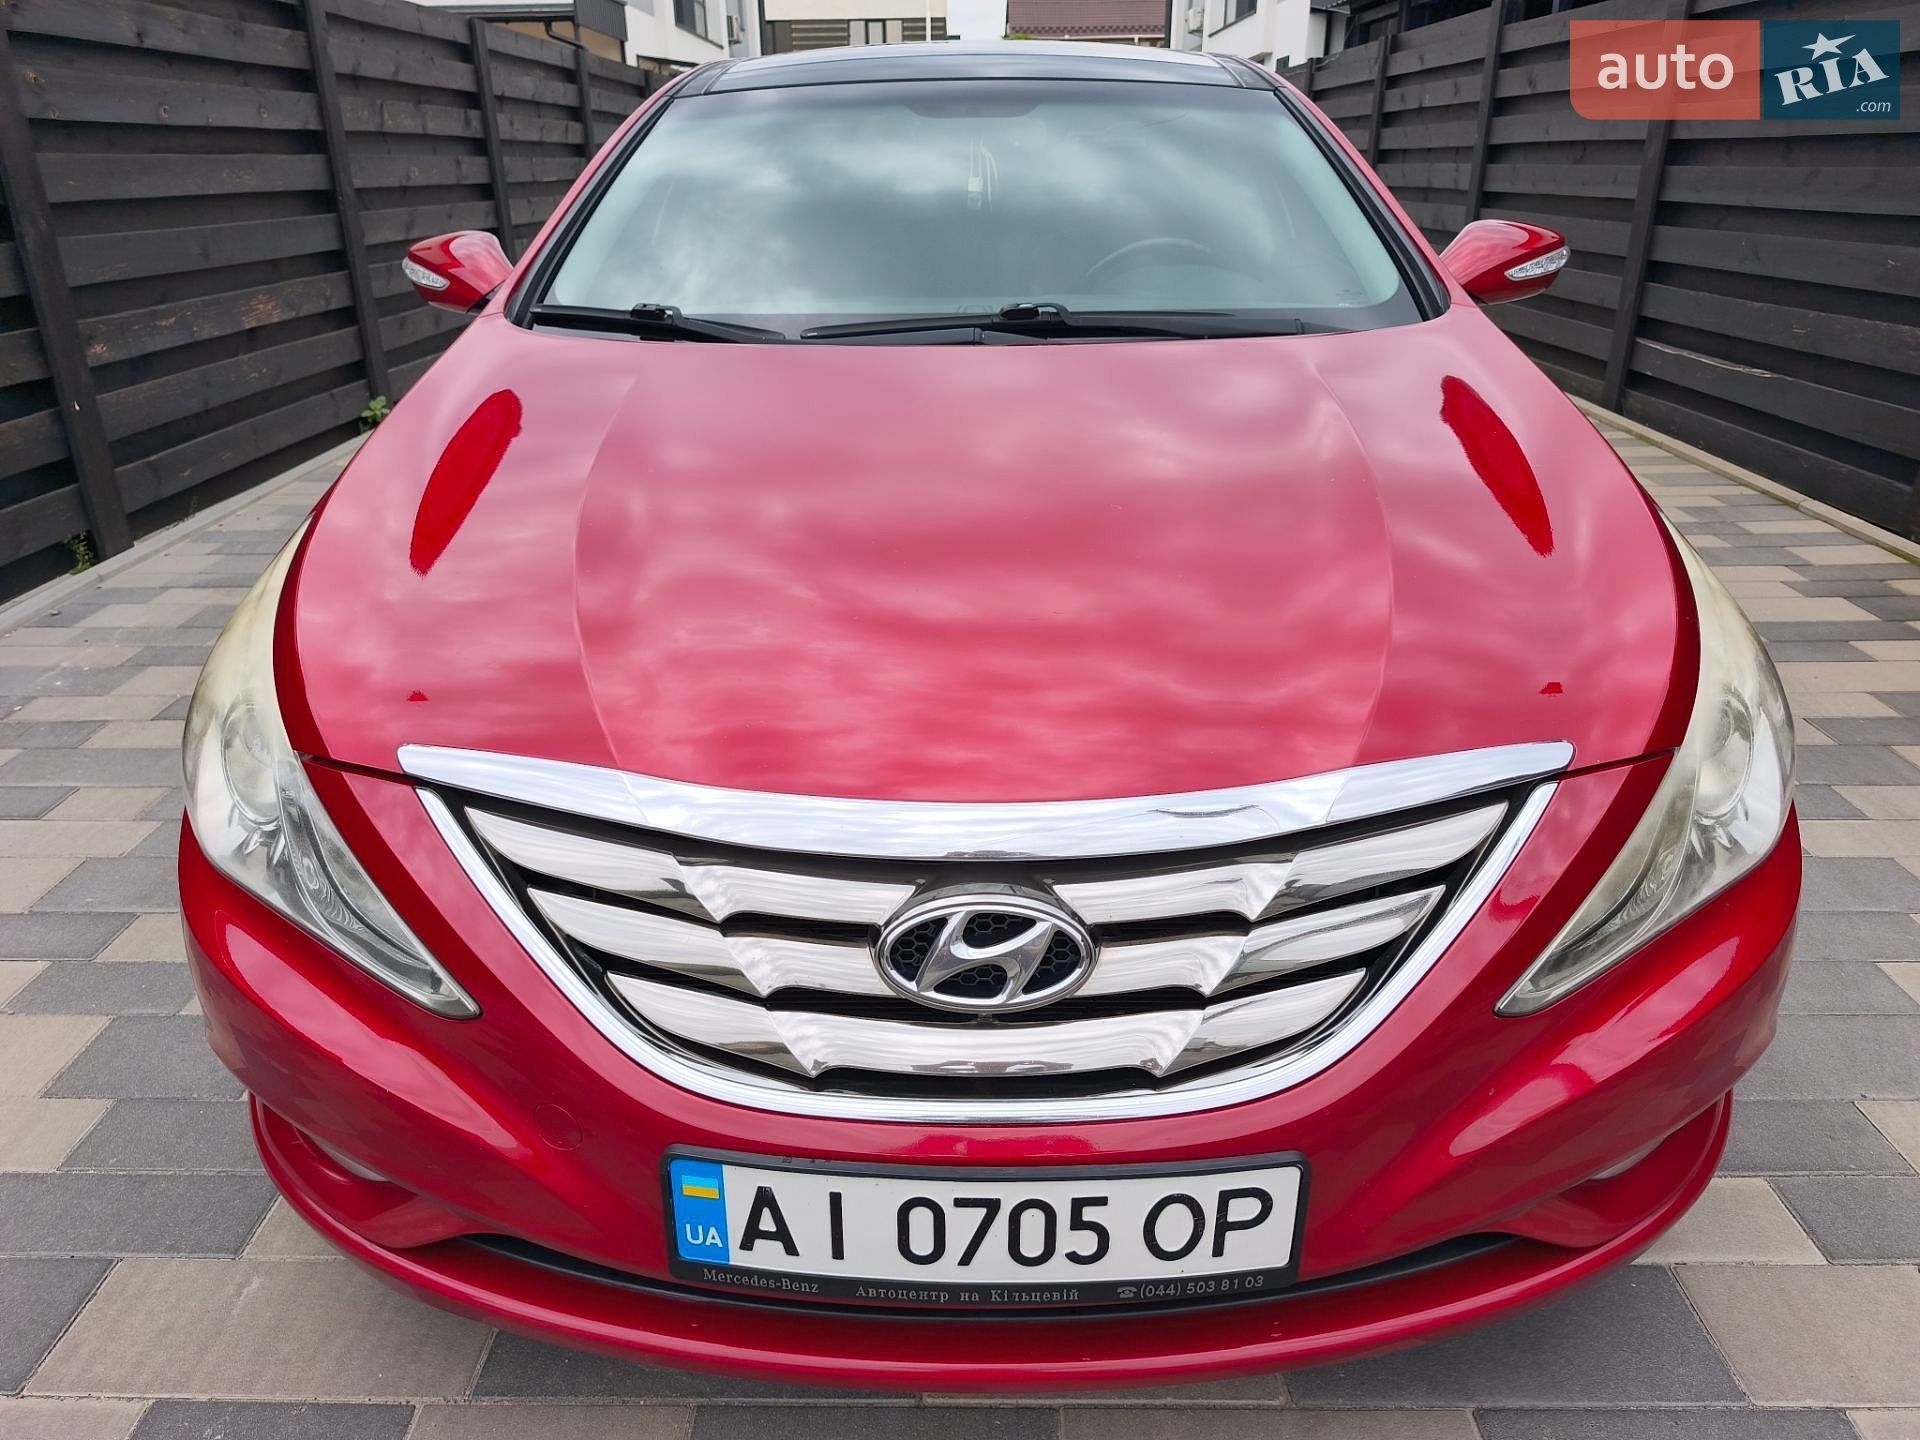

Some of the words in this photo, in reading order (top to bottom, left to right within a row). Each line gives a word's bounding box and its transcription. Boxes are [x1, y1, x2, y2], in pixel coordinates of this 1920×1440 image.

[685, 1223, 723, 1248] UA
[738, 1185, 845, 1260] AI
[896, 1195, 1110, 1267] 0705
[1142, 1186, 1274, 1262] OP
[702, 1268, 820, 1293] Mercedes-Benz
[1139, 1281, 1182, 1299] (044)
[1186, 1279, 1216, 1295] 503
[1244, 1275, 1264, 1289] 03
[855, 1285, 949, 1303] Автоцентр
[959, 1290, 980, 1303] на
[990, 1288, 1081, 1303] Кільцевій
